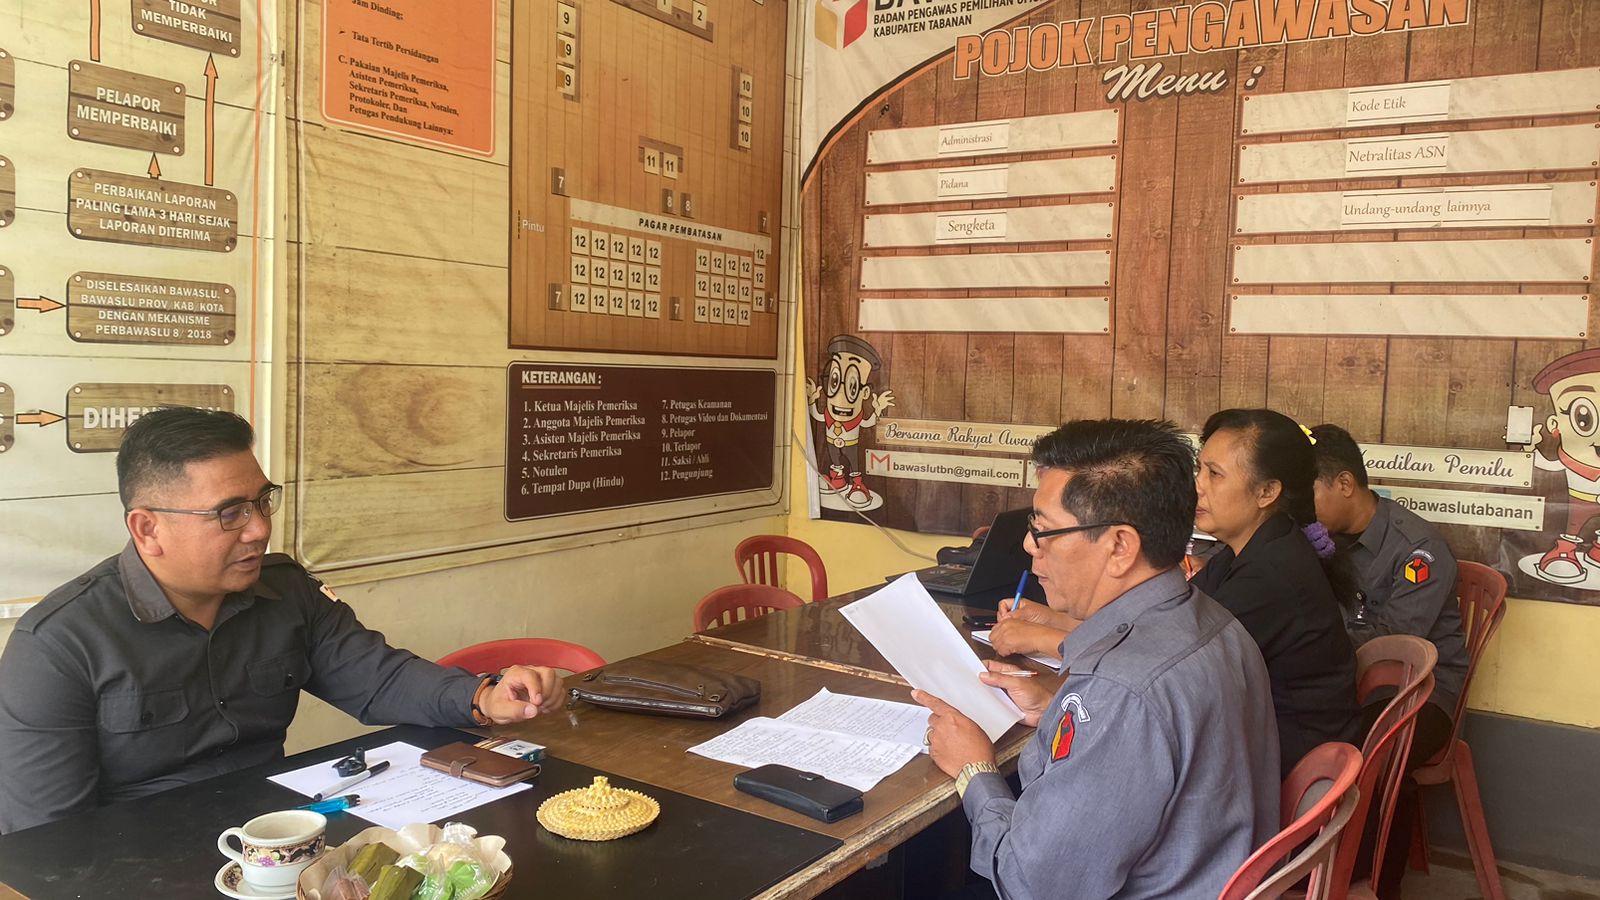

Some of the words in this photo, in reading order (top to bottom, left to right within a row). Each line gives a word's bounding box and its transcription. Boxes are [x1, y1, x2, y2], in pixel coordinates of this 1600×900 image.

[169, 0, 206, 19] TIDAK
[563, 12, 570, 24] 9
[697, 10, 702, 21] 2
[874, 11, 905, 24] BADAN
[908, 3, 958, 20] PENGAWAS
[960, 0, 1013, 12] PEMILIHAN
[141, 9, 232, 42] MEMPERBAIKI
[873, 22, 926, 37] KABUPATEN
[928, 15, 972, 30] TABANAN
[352, 31, 369, 44] Tata
[372, 37, 394, 51] Tertib
[395, 44, 439, 64] Persidangan
[953, 17, 1094, 80] POJOK
[1100, 0, 1471, 62] PENGAWASAN
[565, 43, 572, 57] 9
[338, 54, 347, 64] C.
[350, 58, 380, 73] Pakaian
[383, 66, 409, 81] Majelis
[411, 75, 449, 92] Pemeriksa,
[565, 74, 571, 87] 9
[350, 70, 376, 84] Asisten
[379, 77, 419, 95] Pemeriksa,
[742, 80, 750, 92] 10
[1103, 62, 1227, 102] Menu
[1244, 65, 1263, 89] :
[96, 86, 160, 113] PELAPOR
[350, 81, 388, 98] Sekretaris
[390, 91, 429, 109] Pemeriksa,
[350, 93, 391, 112] Protokoler,
[393, 104, 408, 114] Dan
[741, 105, 750, 117] 10
[1352, 100, 1381, 112] Kode
[1384, 97, 1406, 110] Etik
[77, 105, 176, 136] MEMPERBAIKI
[350, 104, 379, 120] Petugas
[381, 112, 422, 130] Pendukung
[740, 131, 749, 143] 10
[941, 133, 992, 147] Administrasi
[1349, 148, 1412, 162] Netralitas
[1414, 146, 1445, 160] ASN
[647, 155, 656, 168] 11
[666, 160, 674, 173] 11
[558, 176, 564, 189] 7
[940, 178, 968, 189] Pidana
[94, 182, 162, 203] PERBAIKAN
[165, 192, 216, 210] LAPORAN
[667, 196, 673, 208] 8
[685, 200, 691, 212] 8
[76, 198, 120, 214] PALING
[124, 203, 156, 219] LAMA
[159, 208, 166, 220] 3
[169, 210, 196, 224] HARI
[199, 214, 230, 228] SEJAK
[1344, 202, 1441, 217] Undang-undang
[1447, 200, 1491, 214] lainnya
[100, 219, 155, 235] LAPORAN
[158, 226, 210, 242] DITERIMA
[522, 220, 544, 233] Pintu
[638, 218, 667, 232] PAGAR
[669, 221, 722, 241] PEMBATASAN
[762, 217, 767, 228] 7
[948, 218, 995, 235] Sengketa
[574, 235, 586, 248] 12
[594, 238, 605, 251] 12
[613, 241, 624, 254] 12
[631, 244, 642, 257] 12
[649, 247, 659, 260] 12
[698, 255, 707, 267] 12
[713, 257, 722, 269] 12
[728, 259, 736, 271] 12
[741, 261, 750, 273] 12
[574, 264, 586, 277] 12
[594, 266, 605, 279] 12
[613, 269, 623, 282] 12
[631, 271, 641, 284] 12
[649, 273, 658, 286] 12
[86, 280, 166, 295] DISELESAIKAN
[169, 286, 220, 299] BAWASLU.
[698, 280, 707, 292] 12
[713, 282, 721, 294] 12
[727, 284, 736, 295] 12
[741, 285, 749, 297] 12
[81, 294, 135, 307] BAWASLU
[200, 303, 224, 313] KOTA
[555, 292, 561, 304] 7
[574, 293, 585, 305] 12
[594, 295, 605, 307] 12
[612, 297, 623, 309] 12
[631, 298, 640, 311] 12
[648, 300, 657, 313] 12
[674, 303, 680, 315] 7
[98, 310, 144, 322] DENGAN
[147, 314, 210, 326] MEKANISME
[96, 325, 171, 337] PERBAWASLU
[187, 328, 212, 339] 2018
[522, 371, 596, 384] KETERANGAN
[524, 401, 531, 412] 1.
[534, 401, 561, 412] Ketua
[564, 401, 595, 413] Majelis
[597, 401, 638, 411] Pemeriksa
[662, 400, 668, 409] 7.
[670, 400, 697, 410] Petugas
[698, 399, 732, 409] Keamanan
[523, 418, 531, 429] 2.
[533, 418, 570, 431] Anggota
[573, 416, 603, 428] Majelis
[606, 416, 645, 426] Pemeriksa
[662, 414, 668, 424] 8.
[670, 414, 696, 425] Petugas
[698, 413, 716, 422] Video
[717, 413, 729, 422] dan
[730, 411, 768, 421] Dokumentasi
[523, 435, 531, 445] 3.
[533, 434, 565, 445] Asisten
[568, 432, 598, 444] Majelis
[600, 430, 641, 442] Pemeriksa
[662, 429, 668, 438] 9.
[670, 428, 695, 439] Pelapor
[886, 423, 942, 442] Bersama
[948, 426, 992, 449] Rakyat
[522, 452, 530, 462] 4.
[533, 449, 578, 462] Sekretaris
[580, 447, 622, 458] Pemeriksa
[662, 443, 672, 453] 10.
[673, 442, 702, 453] Terlapor
[672, 455, 692, 466] Saksi
[1361, 449, 1435, 473] eadilan
[1444, 454, 1514, 478] Pemilu
[522, 468, 530, 478] 5.
[533, 465, 568, 478] Notulen
[660, 471, 670, 481] 12.
[672, 468, 713, 481] Pengunjung
[893, 462, 1020, 480] bawaslutbn@gmail.com
[521, 484, 530, 495] 6.
[532, 481, 566, 495] Tempat
[568, 479, 590, 492] Dupa
[593, 476, 624, 489] (Hindu)
[1395, 496, 1533, 520] @bawaslutabanan
